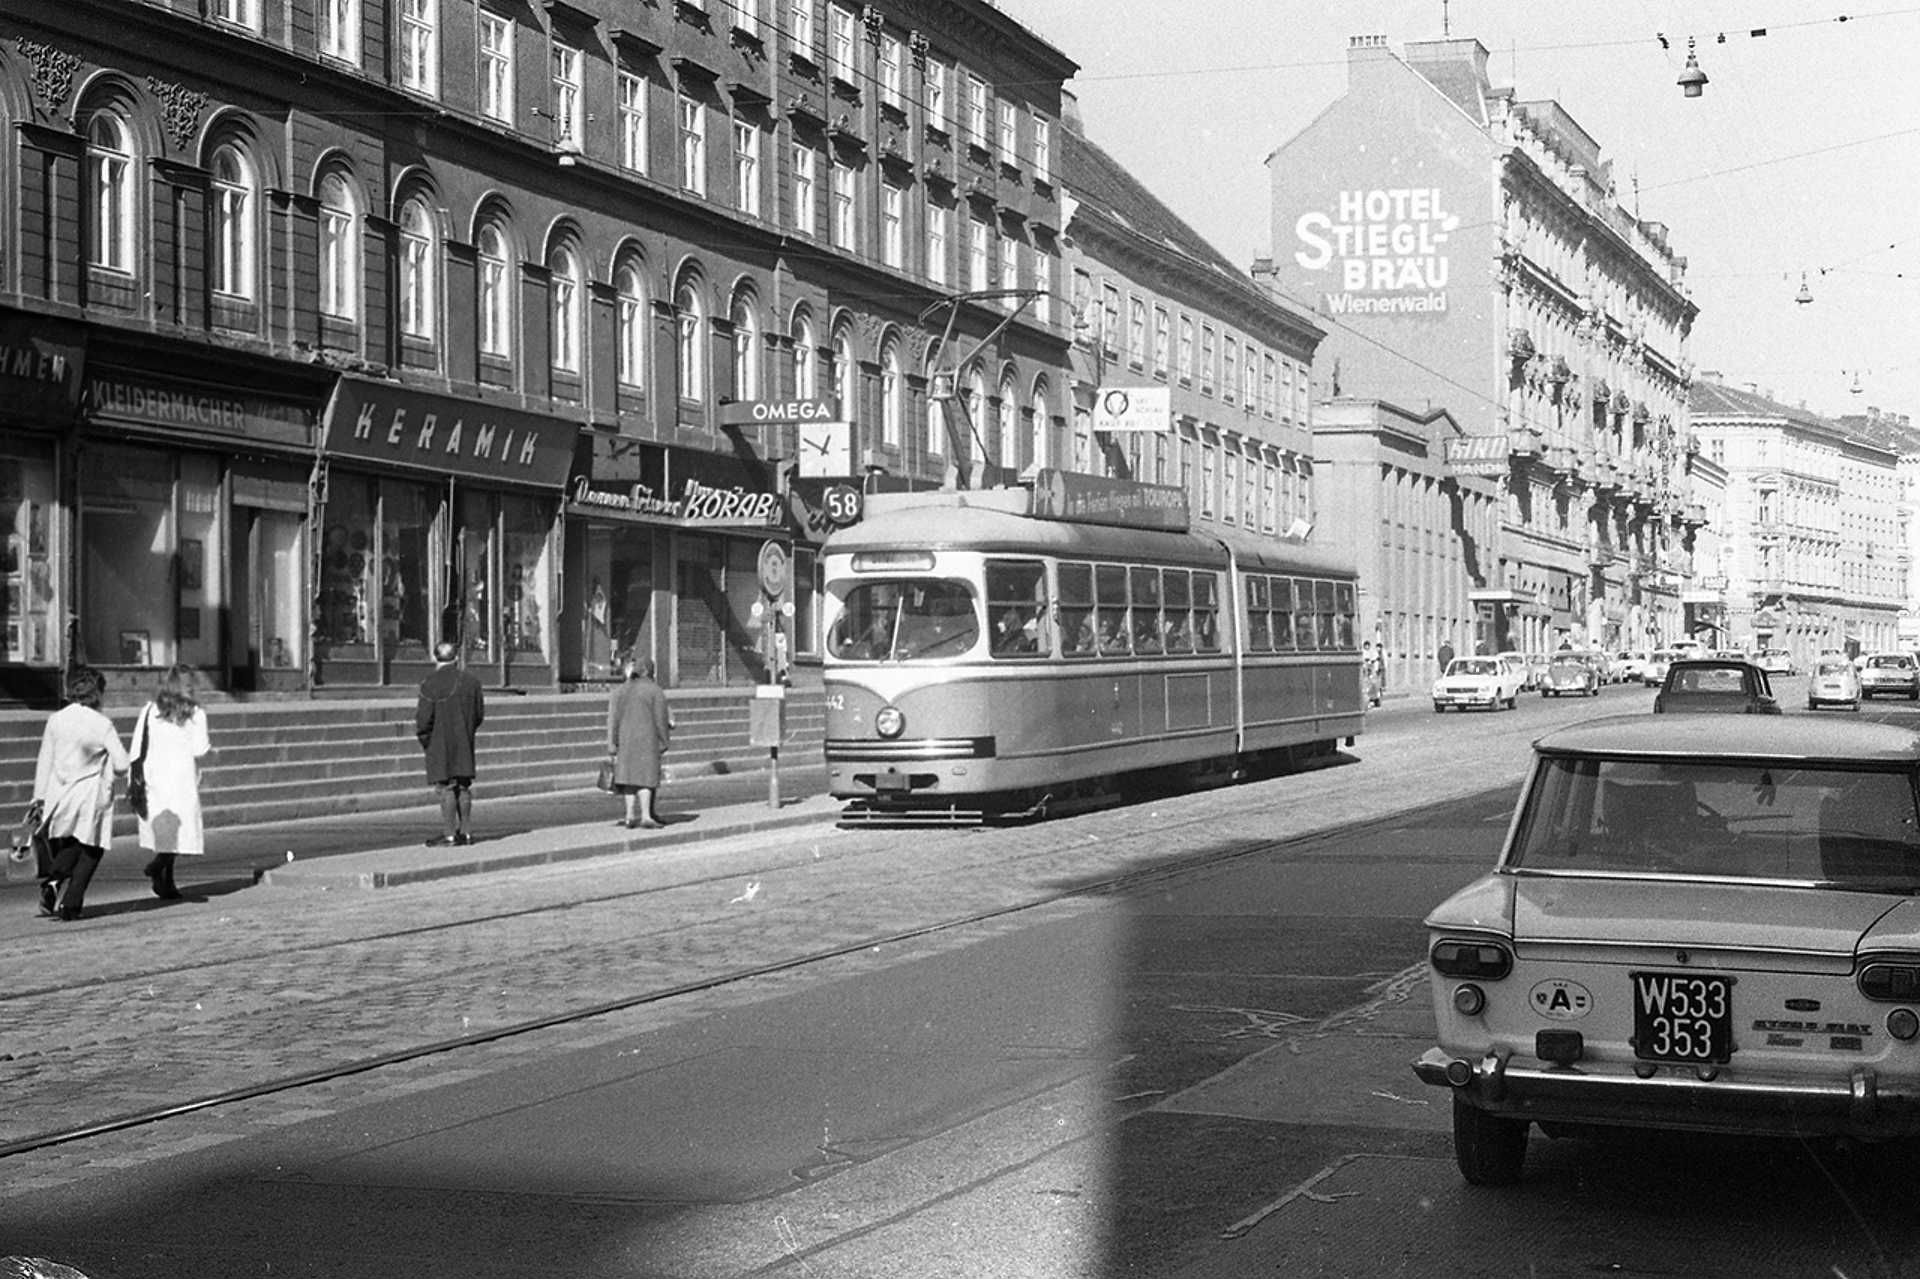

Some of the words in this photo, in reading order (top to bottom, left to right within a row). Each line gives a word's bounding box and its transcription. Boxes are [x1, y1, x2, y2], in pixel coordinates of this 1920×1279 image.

[1339, 187, 1448, 222] HOTEL
[1343, 256, 1449, 290] BRÄU
[1326, 292, 1447, 314] Wienerwald
[91, 379, 246, 431] KLEIDERMACHER
[752, 402, 831, 420] OMEGA
[354, 402, 539, 465] KERAMIK
[684, 490, 774, 521] KORAB
[828, 492, 858, 518] 58
[1550, 988, 1571, 1011] A
[1638, 977, 1726, 1019] W533
[1652, 1017, 1712, 1058] 353
